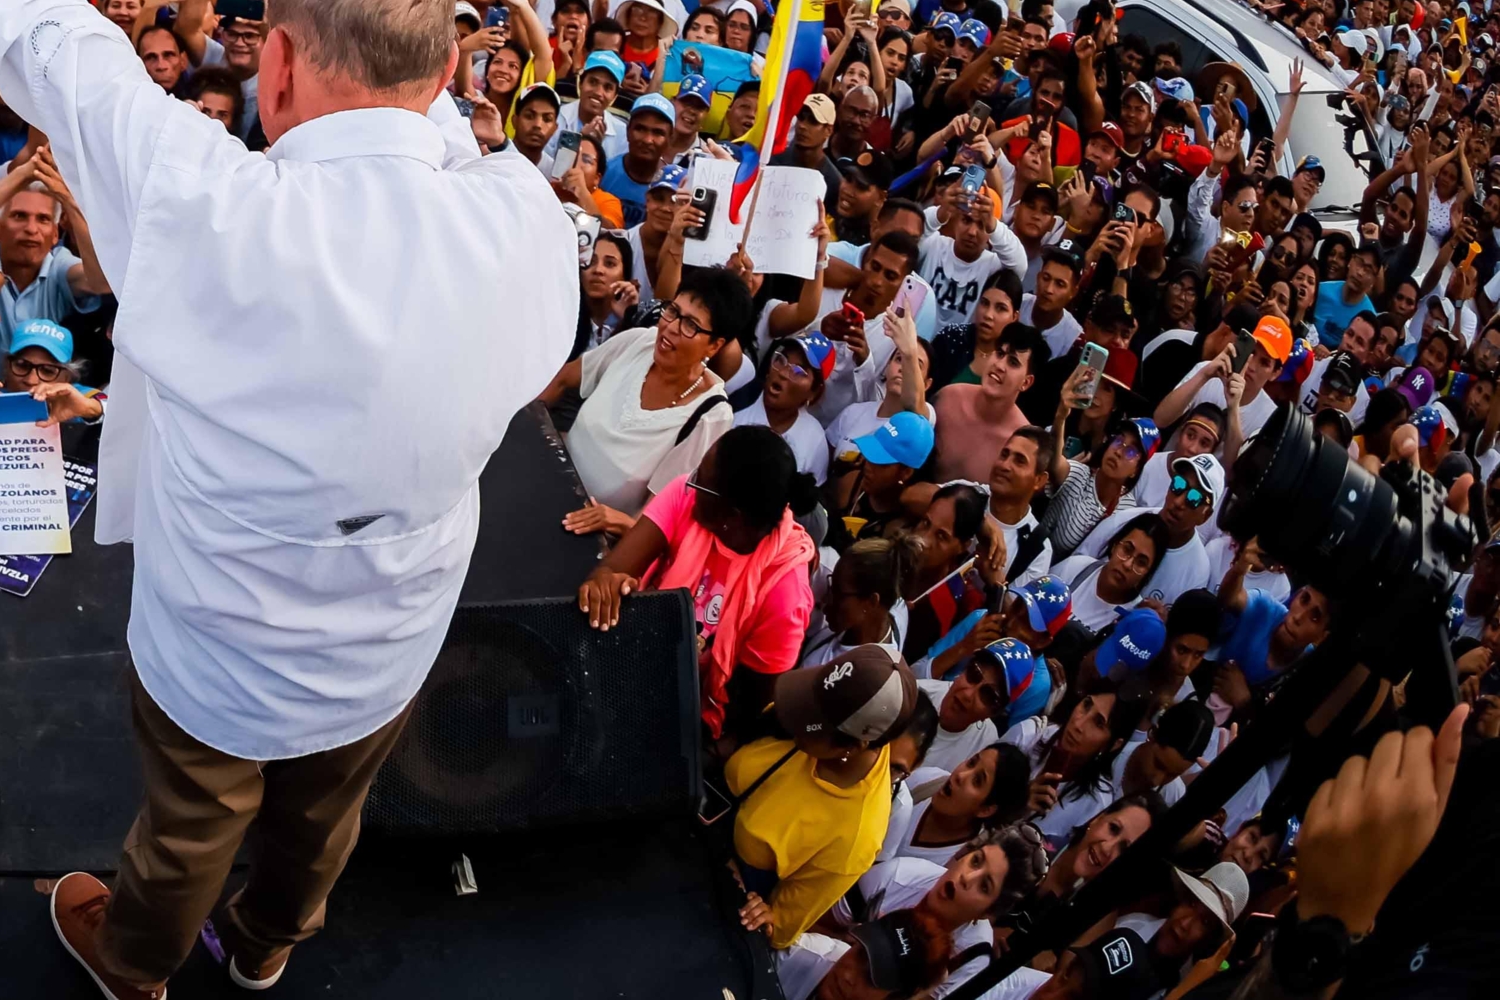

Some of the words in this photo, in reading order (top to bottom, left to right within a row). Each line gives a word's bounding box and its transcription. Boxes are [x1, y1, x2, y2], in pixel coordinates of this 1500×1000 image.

[931, 266, 979, 316] GAP
[1412, 374, 1425, 390] NY
[71, 463, 93, 476] POR
[74, 473, 96, 485] POR
